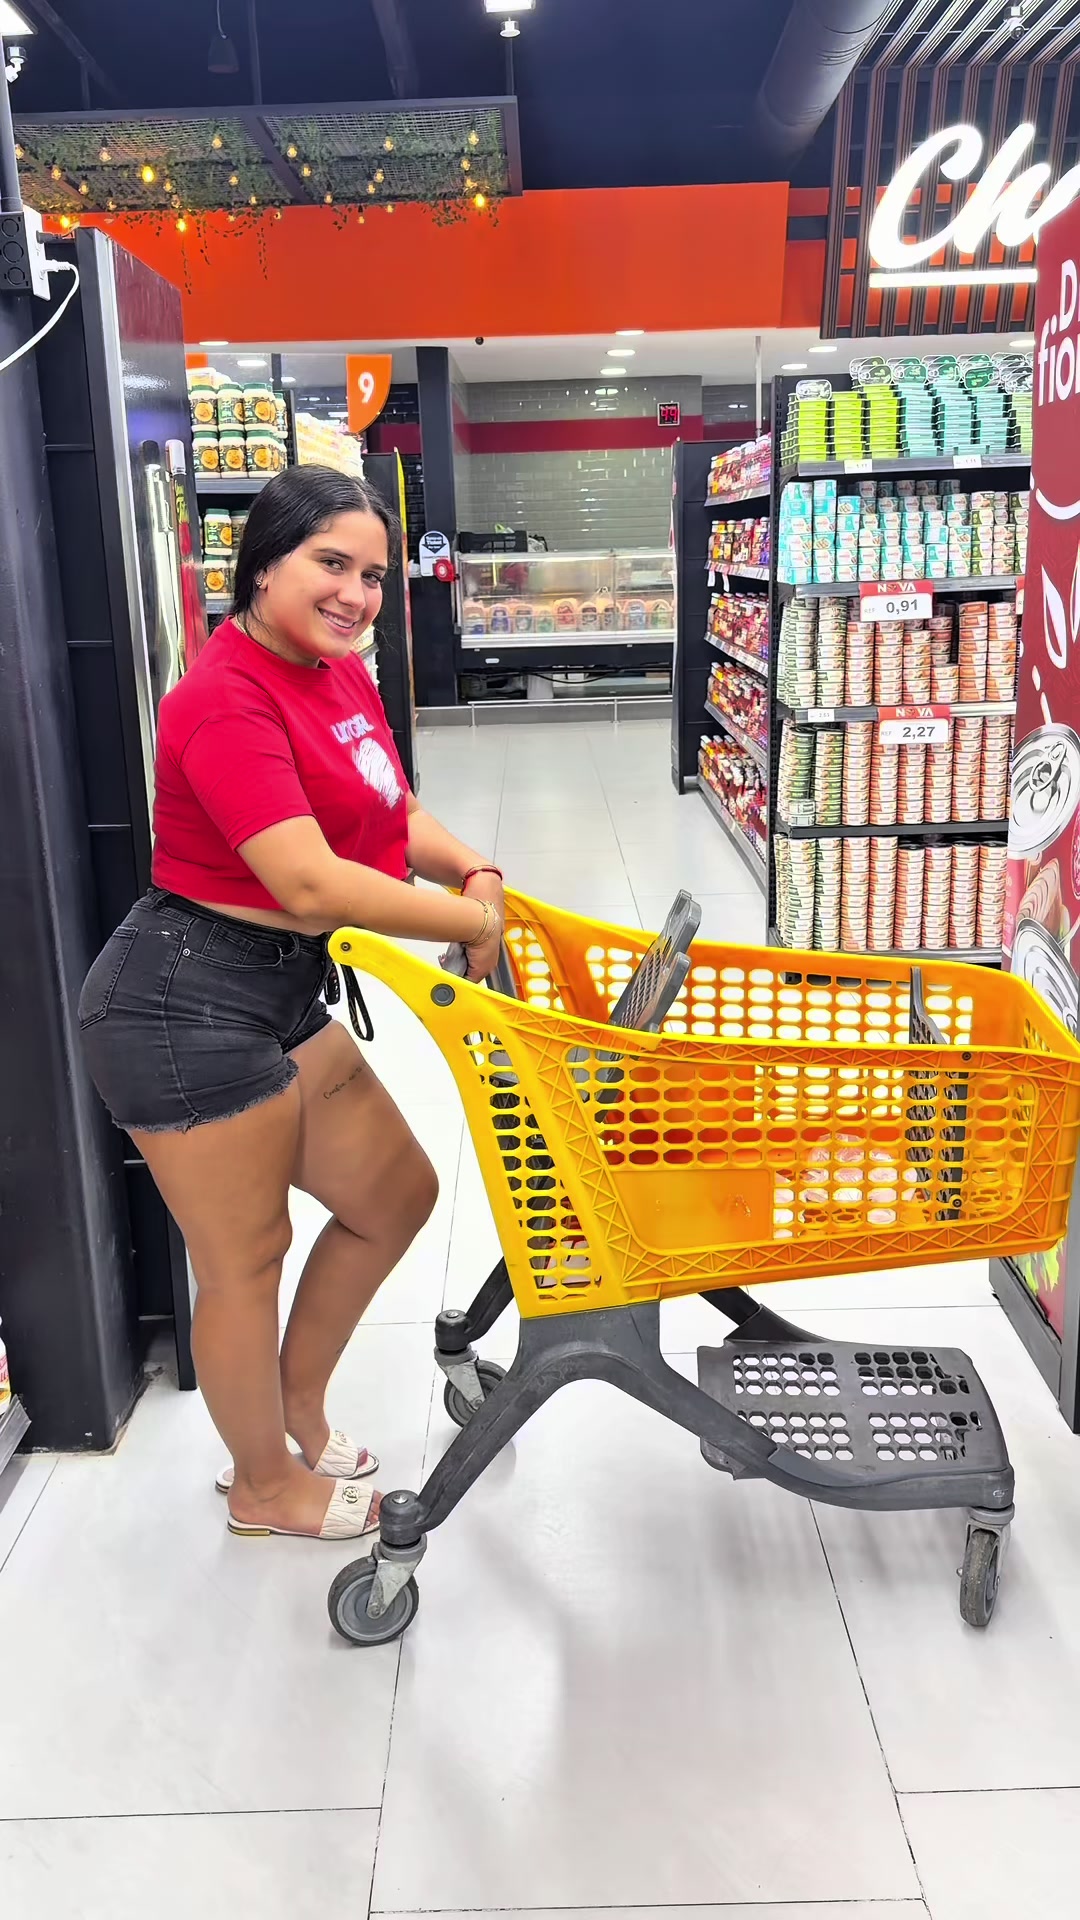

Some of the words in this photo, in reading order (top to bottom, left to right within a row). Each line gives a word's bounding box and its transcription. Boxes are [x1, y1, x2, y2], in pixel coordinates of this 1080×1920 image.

[1059, 259, 1080, 332] D
[1038, 314, 1080, 407] fio
[357, 371, 375, 404] 9
[886, 599, 918, 615] 0,91
[902, 726, 936, 740] 2,27
